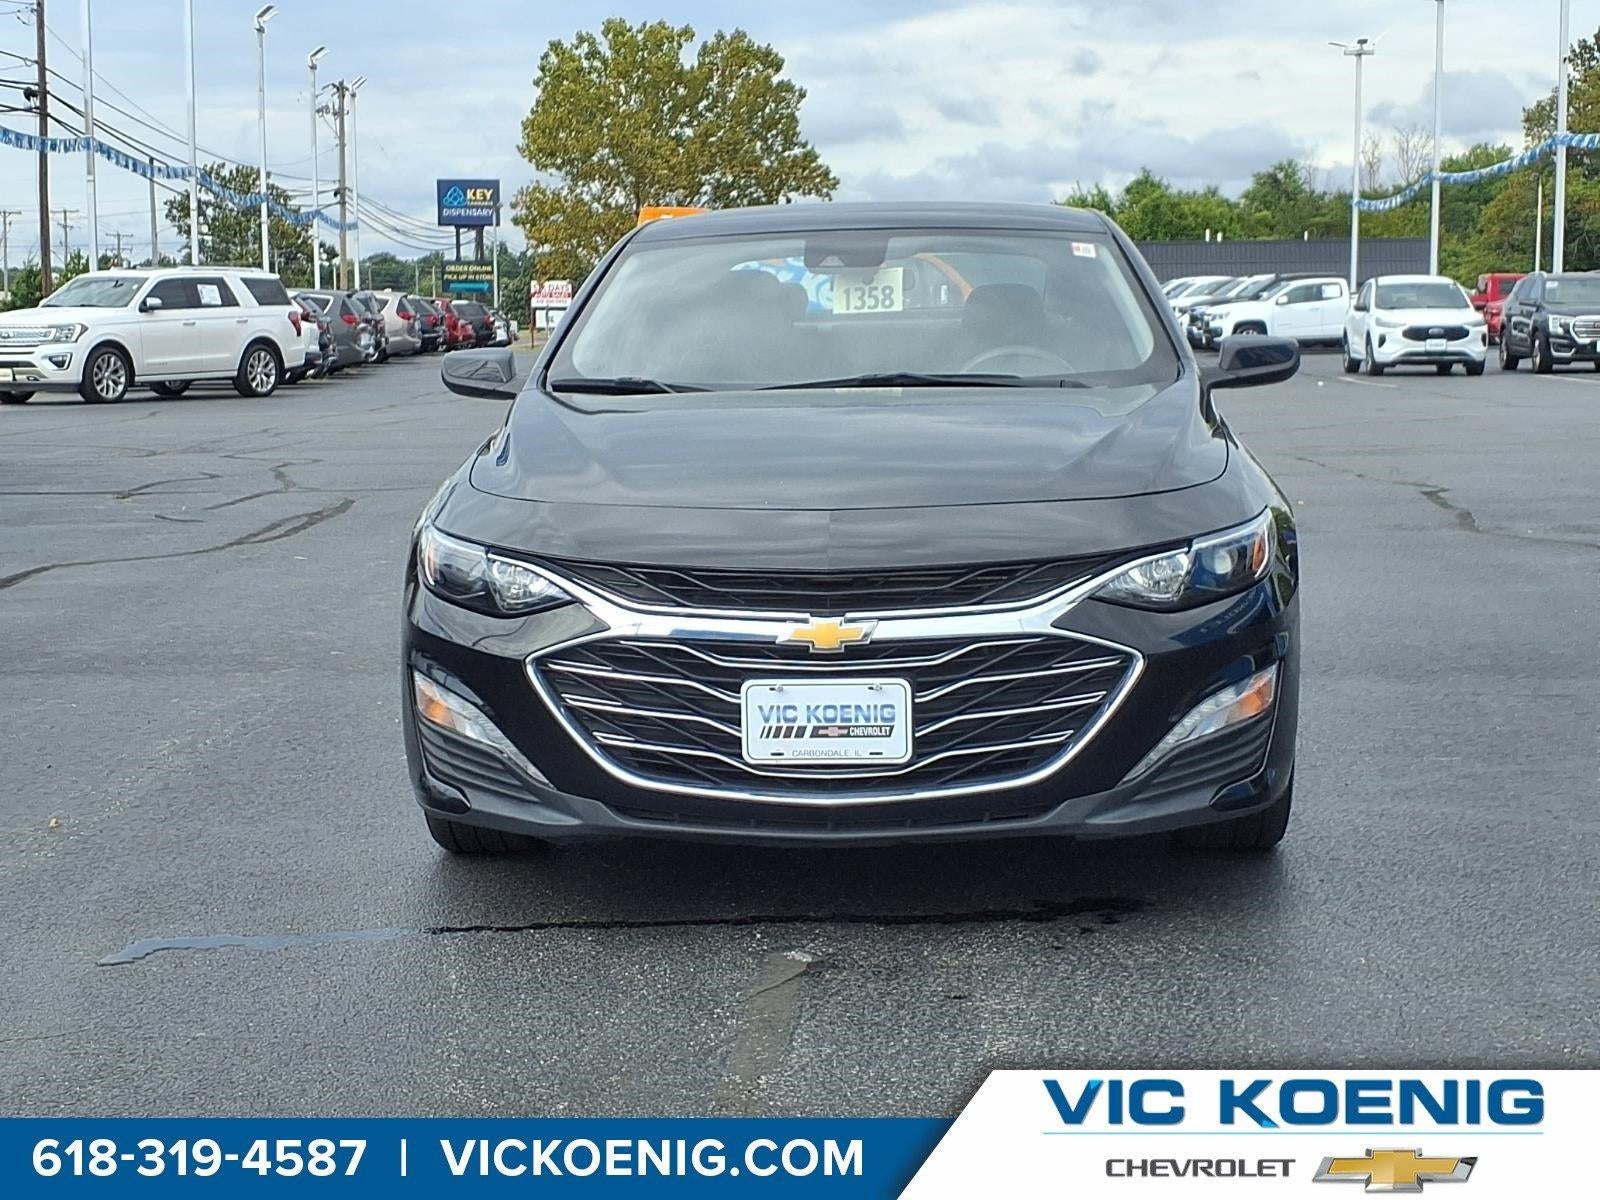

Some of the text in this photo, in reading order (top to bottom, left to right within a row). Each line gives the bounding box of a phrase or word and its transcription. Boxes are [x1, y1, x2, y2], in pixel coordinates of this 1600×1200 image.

[466, 188, 493, 200] KEY
[443, 208, 493, 217] DISPENSARY
[843, 286, 895, 311] 1358
[757, 703, 896, 724] VIC KOENIG
[849, 726, 891, 736] CHEVROLET
[854, 749, 863, 757] IL
